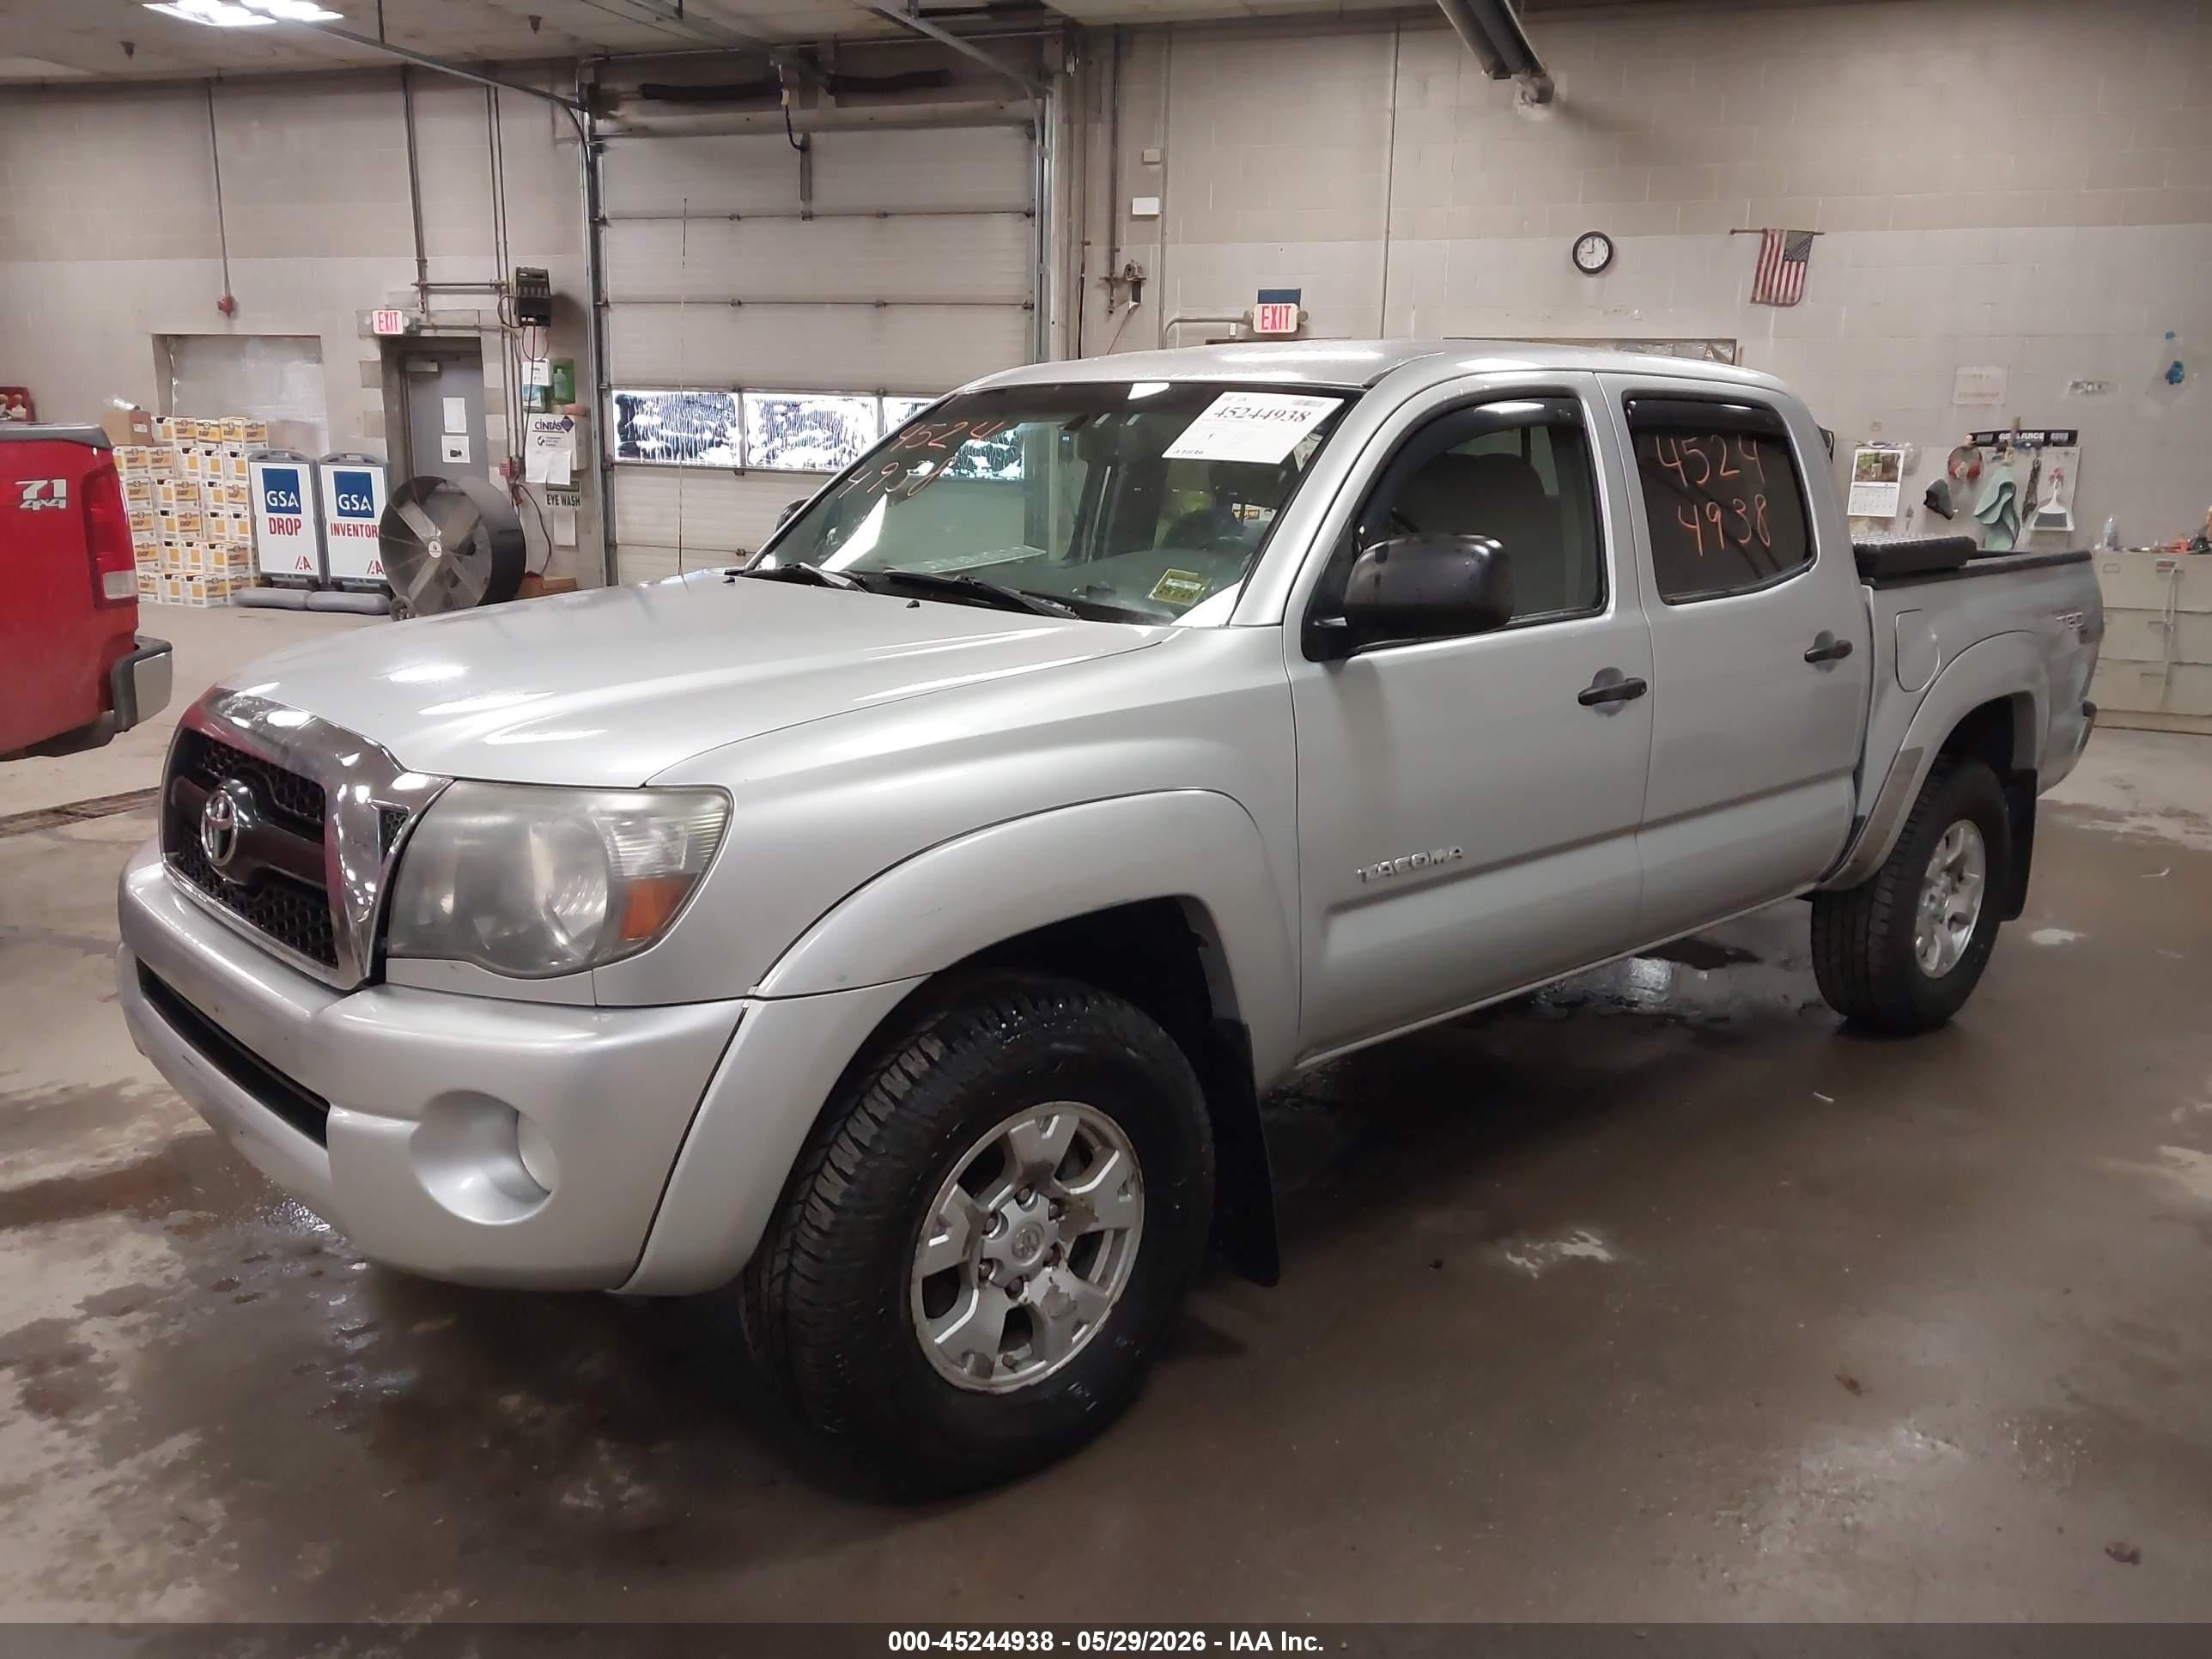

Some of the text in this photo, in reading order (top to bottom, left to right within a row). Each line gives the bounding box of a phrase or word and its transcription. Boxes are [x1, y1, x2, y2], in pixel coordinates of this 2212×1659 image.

[378, 311, 398, 331] EXIT
[1261, 305, 1291, 331] EXIT
[1214, 405, 1312, 422] 45244938
[535, 418, 562, 430] CINTAS
[890, 421, 1005, 453] 4524
[1655, 434, 1766, 487] 4524
[837, 457, 957, 499] 4938
[266, 490, 300, 508] GSA
[337, 493, 373, 512] GSA
[546, 494, 581, 507] EYE WASH
[268, 516, 301, 537] DROP
[330, 522, 380, 538] INVENTOR
[1678, 494, 1771, 556] 4938
[1356, 845, 1463, 883] TACOMA
